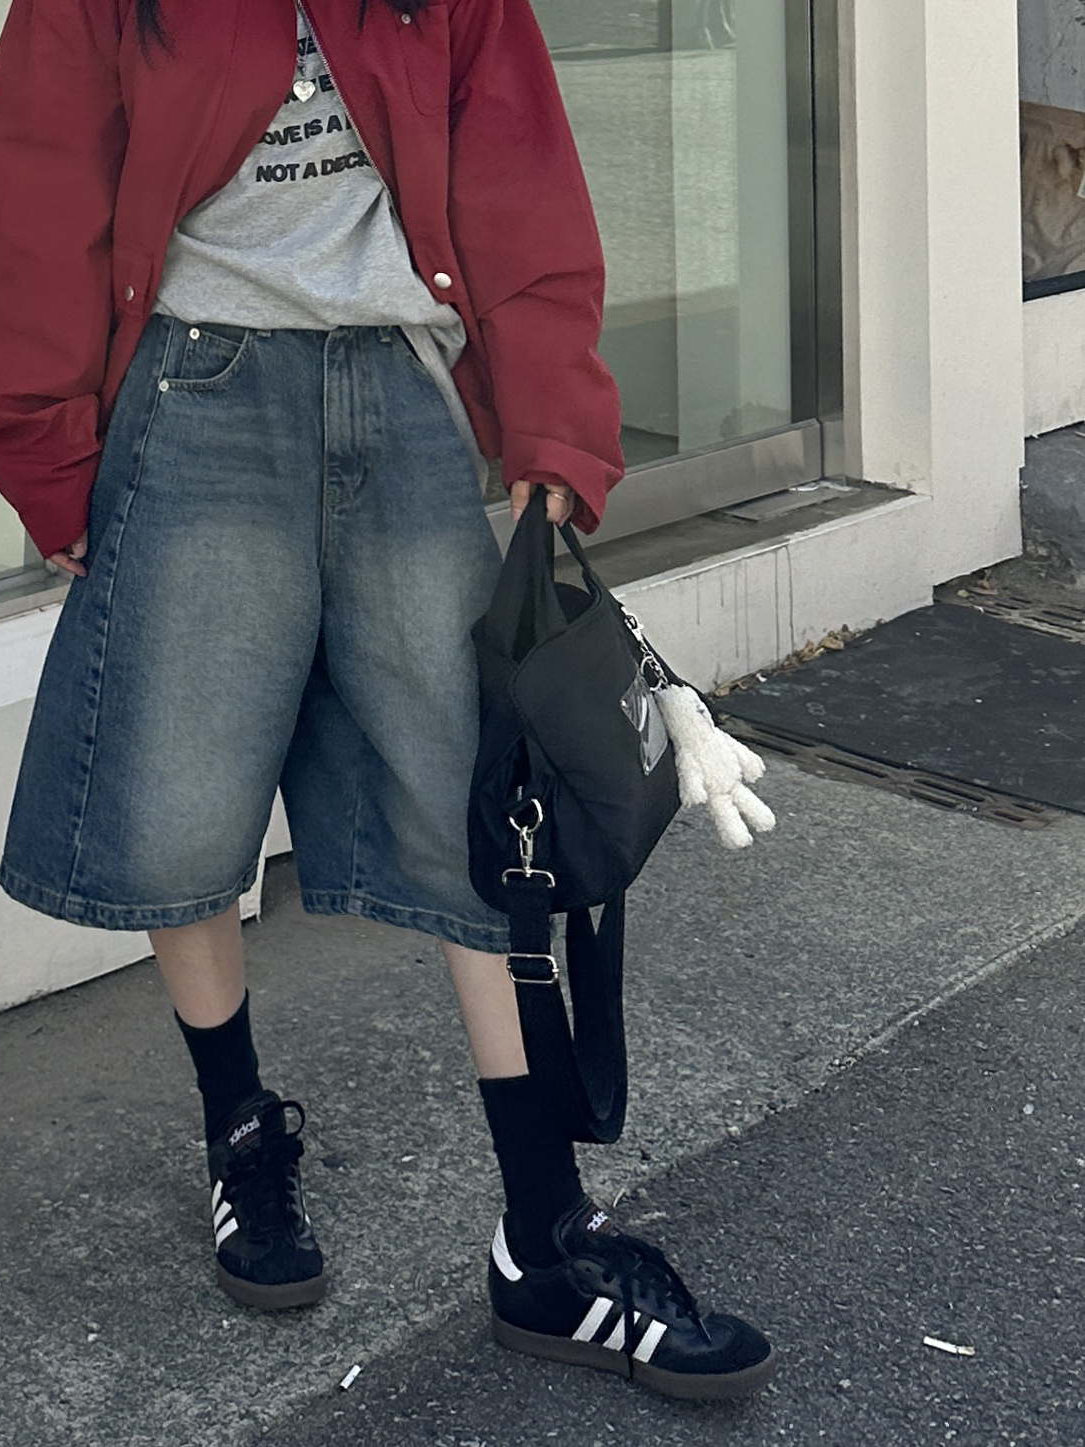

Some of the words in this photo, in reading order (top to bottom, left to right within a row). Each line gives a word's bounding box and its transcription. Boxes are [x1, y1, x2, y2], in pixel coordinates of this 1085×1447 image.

[257, 124, 303, 147] OVE
[303, 118, 324, 139] IS
[326, 114, 343, 133] A
[256, 163, 300, 183] NOT
[302, 162, 319, 180] A
